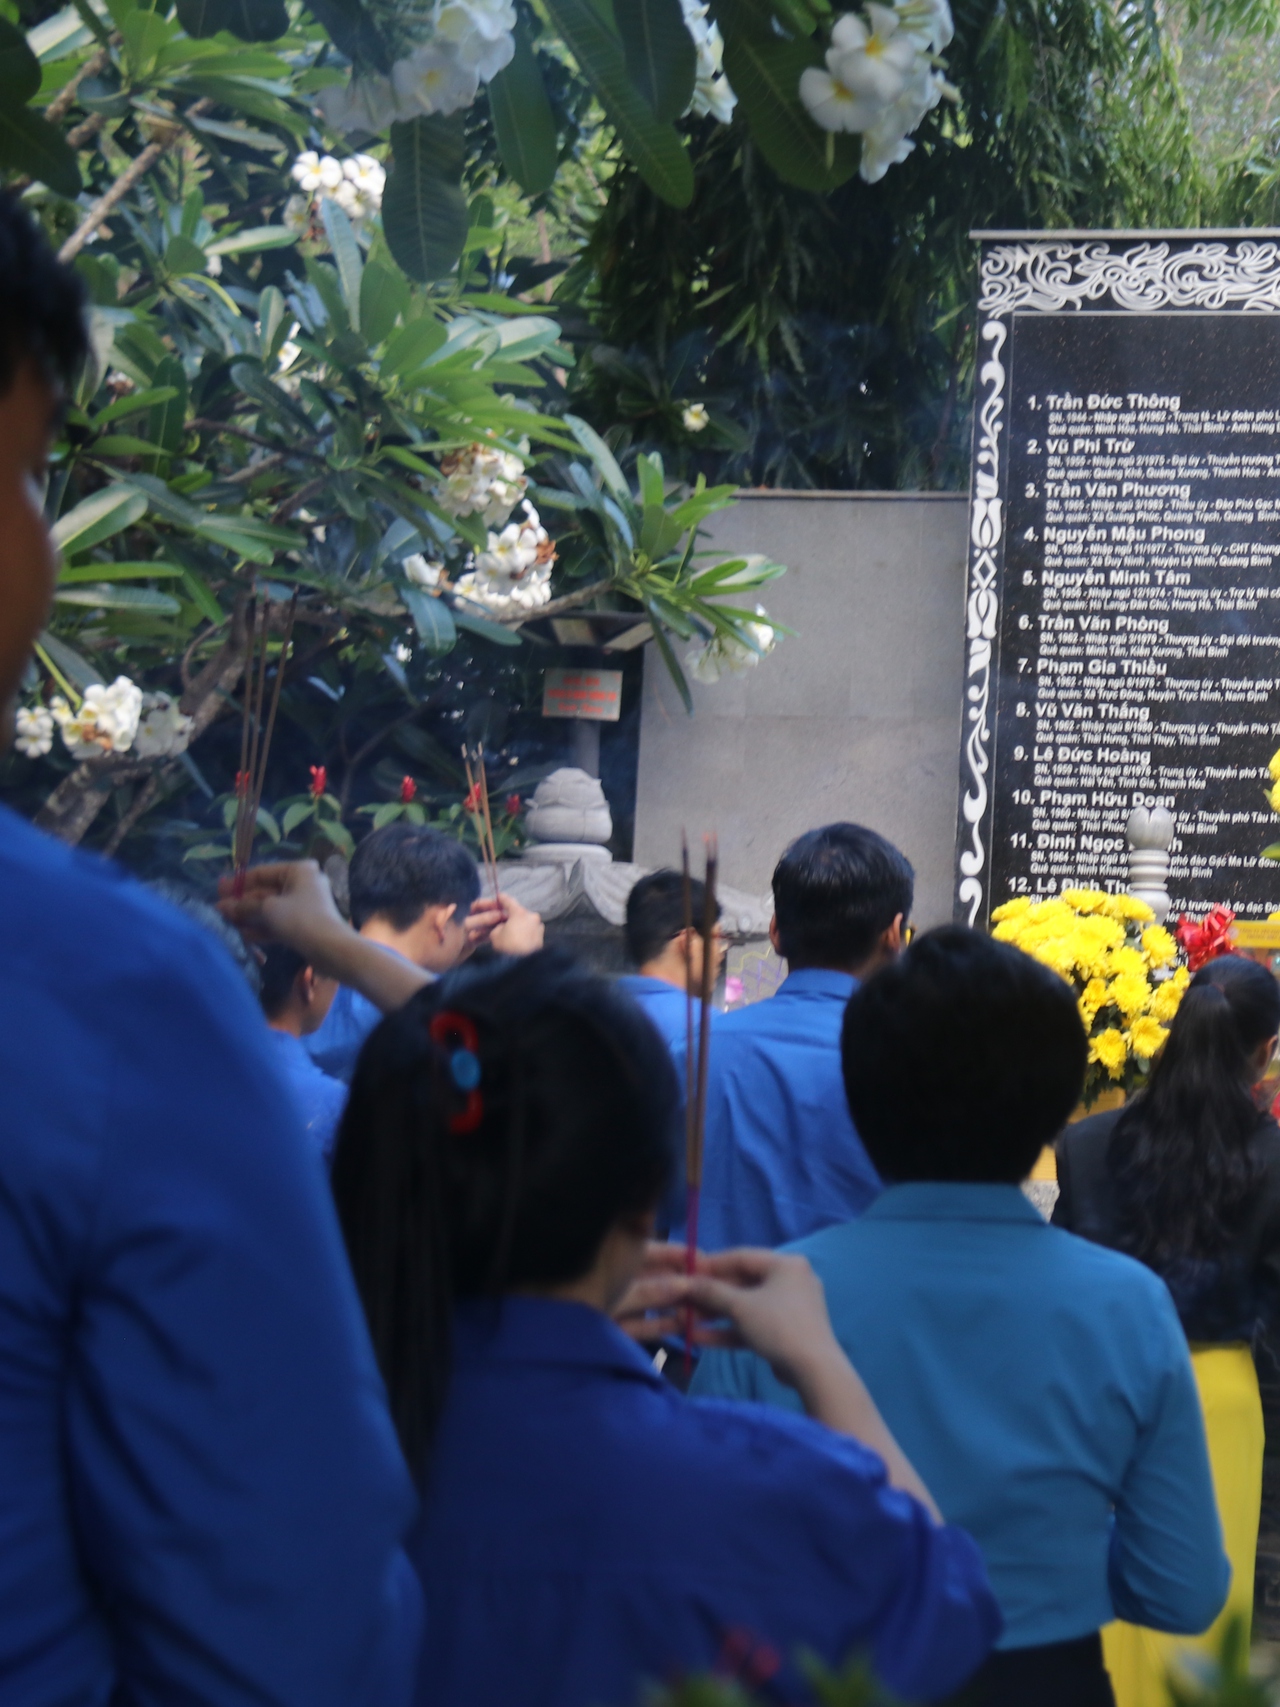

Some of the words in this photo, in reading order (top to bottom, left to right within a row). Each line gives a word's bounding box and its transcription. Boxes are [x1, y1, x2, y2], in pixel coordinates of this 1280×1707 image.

[1028, 394, 1042, 410] 1.
[1046, 392, 1083, 410] Trần
[1087, 394, 1123, 410] Đức
[1127, 393, 1181, 412] Thông
[1027, 439, 1042, 454] 2.
[1046, 438, 1069, 454] Vũ
[1073, 438, 1100, 454] Phi
[1025, 482, 1039, 498] 3.
[1044, 480, 1081, 497] Trần
[1085, 482, 1117, 497] Văn
[1122, 482, 1191, 500] Phương
[1024, 526, 1039, 541] 4.
[1044, 524, 1107, 544] Nguyễn
[1111, 525, 1146, 543] Mậu
[1151, 526, 1205, 544] Phong
[1022, 570, 1037, 585] 5.
[1041, 568, 1105, 588] Nguyễn
[1110, 570, 1150, 585] Minh
[1155, 570, 1191, 585] Tâm
[1018, 615, 1033, 630] 6.
[1079, 615, 1111, 630] Văn
[1017, 658, 1032, 673] 7.
[1037, 658, 1084, 677] Phạm
[1088, 658, 1116, 674] Gia
[1016, 702, 1031, 717] 8.
[1035, 702, 1057, 718] Vũ
[1061, 702, 1093, 718] Văn
[1098, 700, 1150, 722] Thắng
[1013, 746, 1029, 761] 9.
[1033, 745, 1053, 762] Lê
[1058, 746, 1093, 762] Đức
[1012, 790, 1035, 805] 10.
[1040, 790, 1087, 809] Phạm
